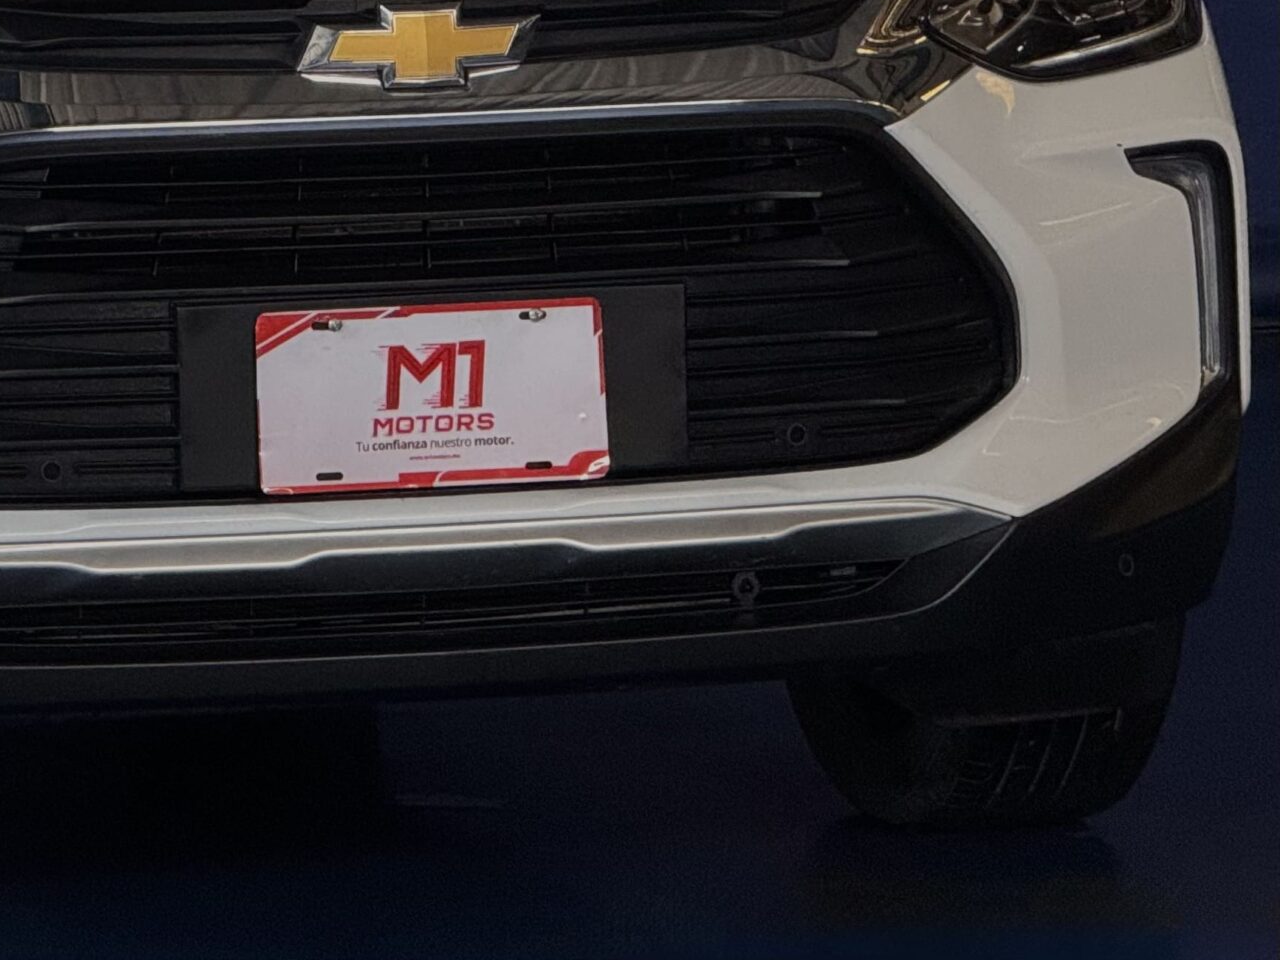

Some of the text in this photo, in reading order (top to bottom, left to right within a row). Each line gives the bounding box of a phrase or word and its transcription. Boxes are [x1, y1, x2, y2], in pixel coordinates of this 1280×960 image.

[374, 339, 486, 411] M1
[372, 412, 496, 438] MOTORS
[356, 436, 515, 453] Tu confianza nuestro motor.
